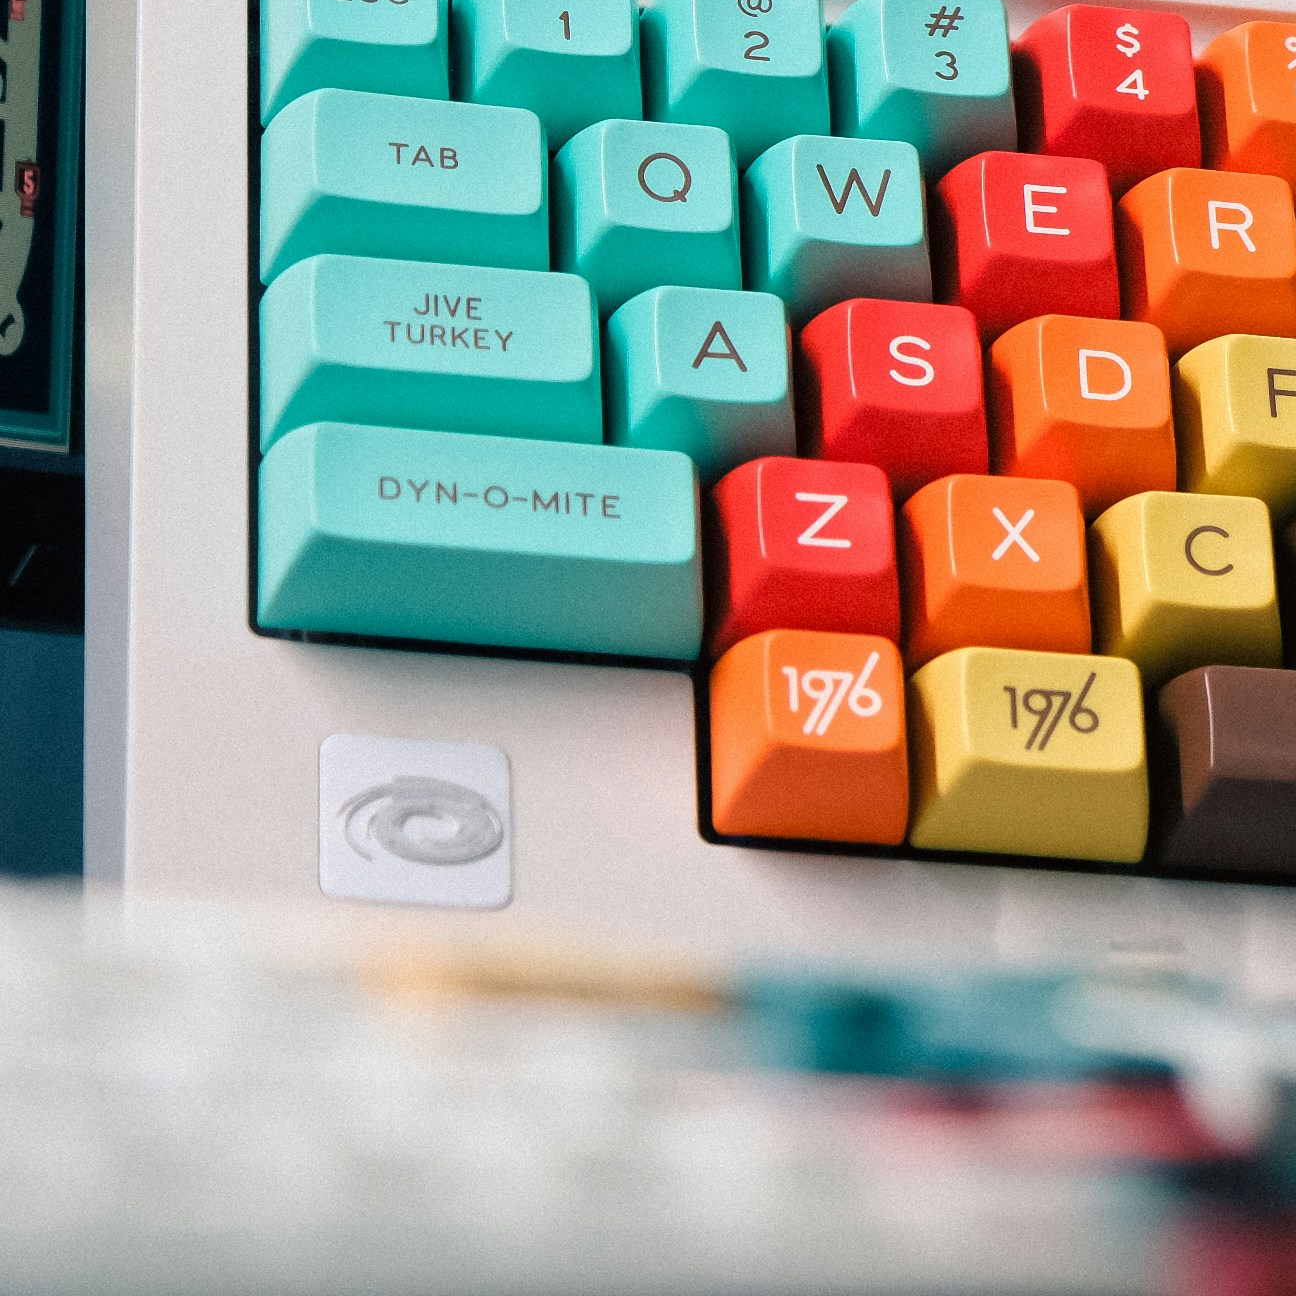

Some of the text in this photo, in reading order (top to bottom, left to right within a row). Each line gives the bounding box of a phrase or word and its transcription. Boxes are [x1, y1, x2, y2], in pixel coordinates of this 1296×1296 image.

[559, 10, 571, 40] 1
[743, 30, 770, 62] 2
[925, 6, 964, 38] #
[1115, 22, 1142, 58] $
[935, 50, 959, 81] 3
[1116, 69, 1149, 100] 4
[390, 142, 459, 169] TAB
[638, 152, 691, 202] Q
[817, 164, 890, 216] W
[1024, 184, 1069, 235] E
[1208, 201, 1256, 252] R
[414, 293, 482, 321] JIVE
[384, 321, 513, 352] TURKEY
[693, 321, 746, 371] A
[889, 336, 934, 386] S
[1079, 349, 1132, 401] D
[379, 476, 619, 518] DYN-O-MITE
[796, 493, 851, 548] Z
[992, 508, 1040, 562] X
[1184, 524, 1236, 577] C
[783, 652, 883, 735] 1976
[1004, 672, 1099, 750] 1976
